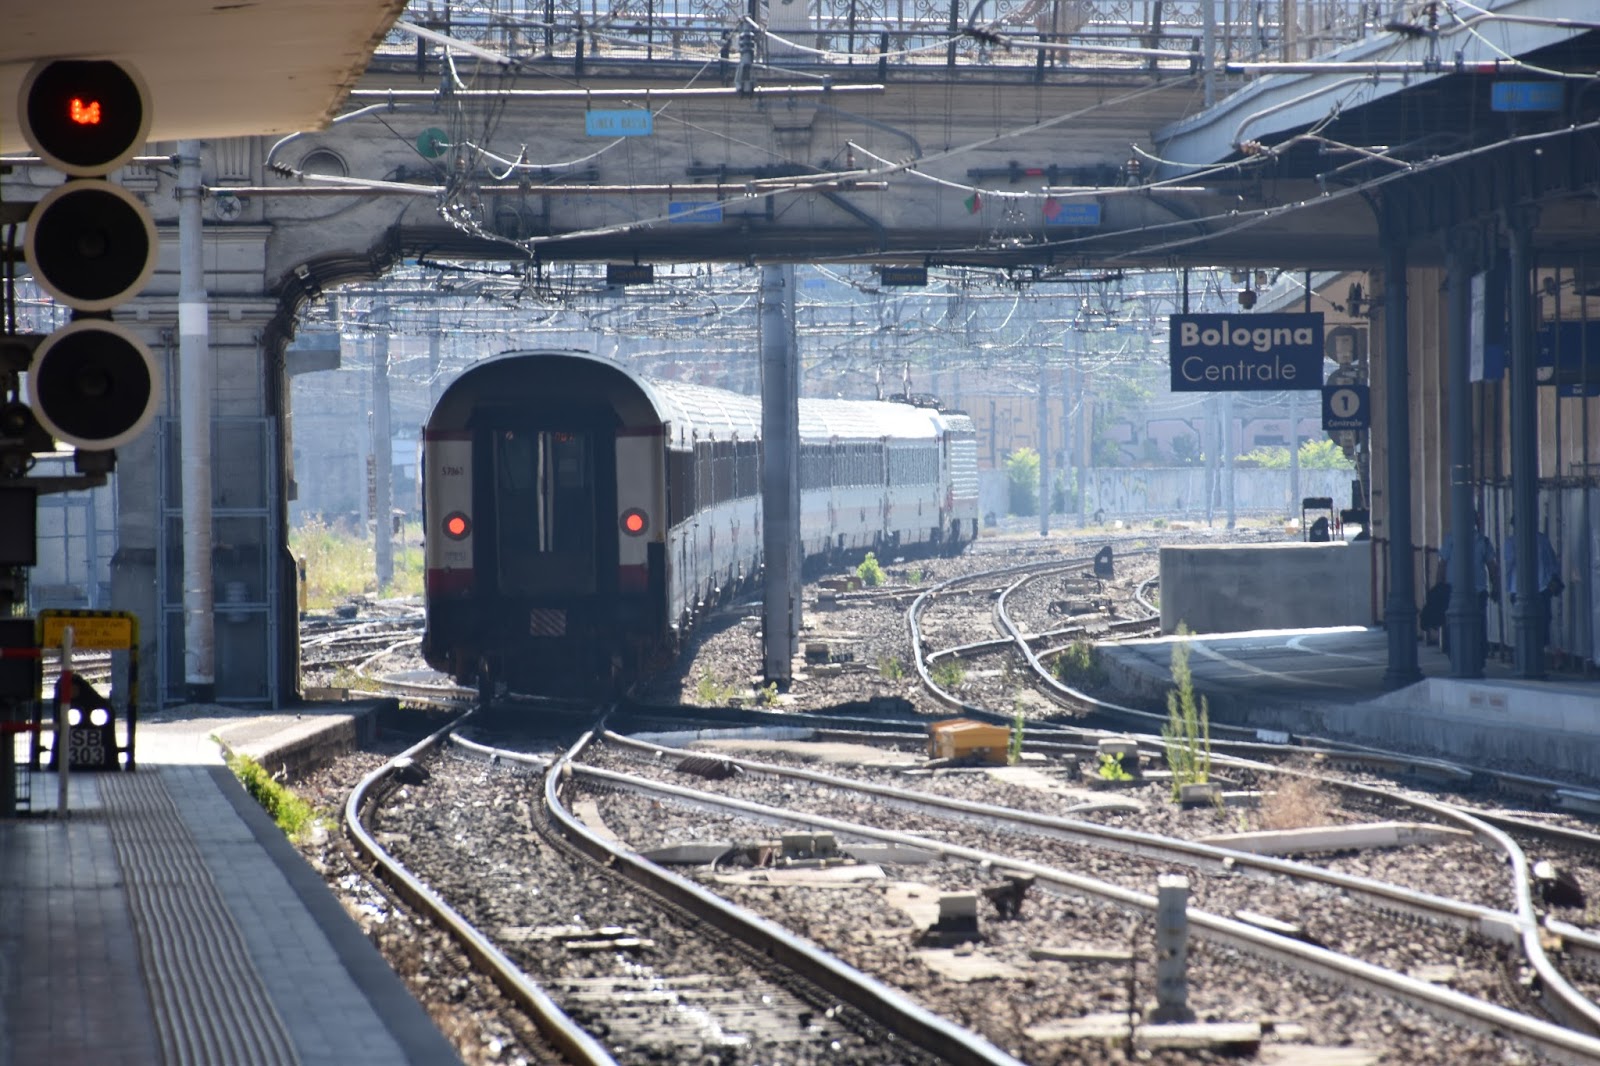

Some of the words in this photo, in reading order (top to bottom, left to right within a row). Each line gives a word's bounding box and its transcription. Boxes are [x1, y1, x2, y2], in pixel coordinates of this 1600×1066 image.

[1181, 320, 1312, 352] Bologna
[1181, 355, 1297, 381] Centrale
[1341, 396, 1349, 411] 1
[1328, 419, 1363, 428] Centrale
[72, 730, 101, 746] SB
[69, 747, 104, 764] 303
